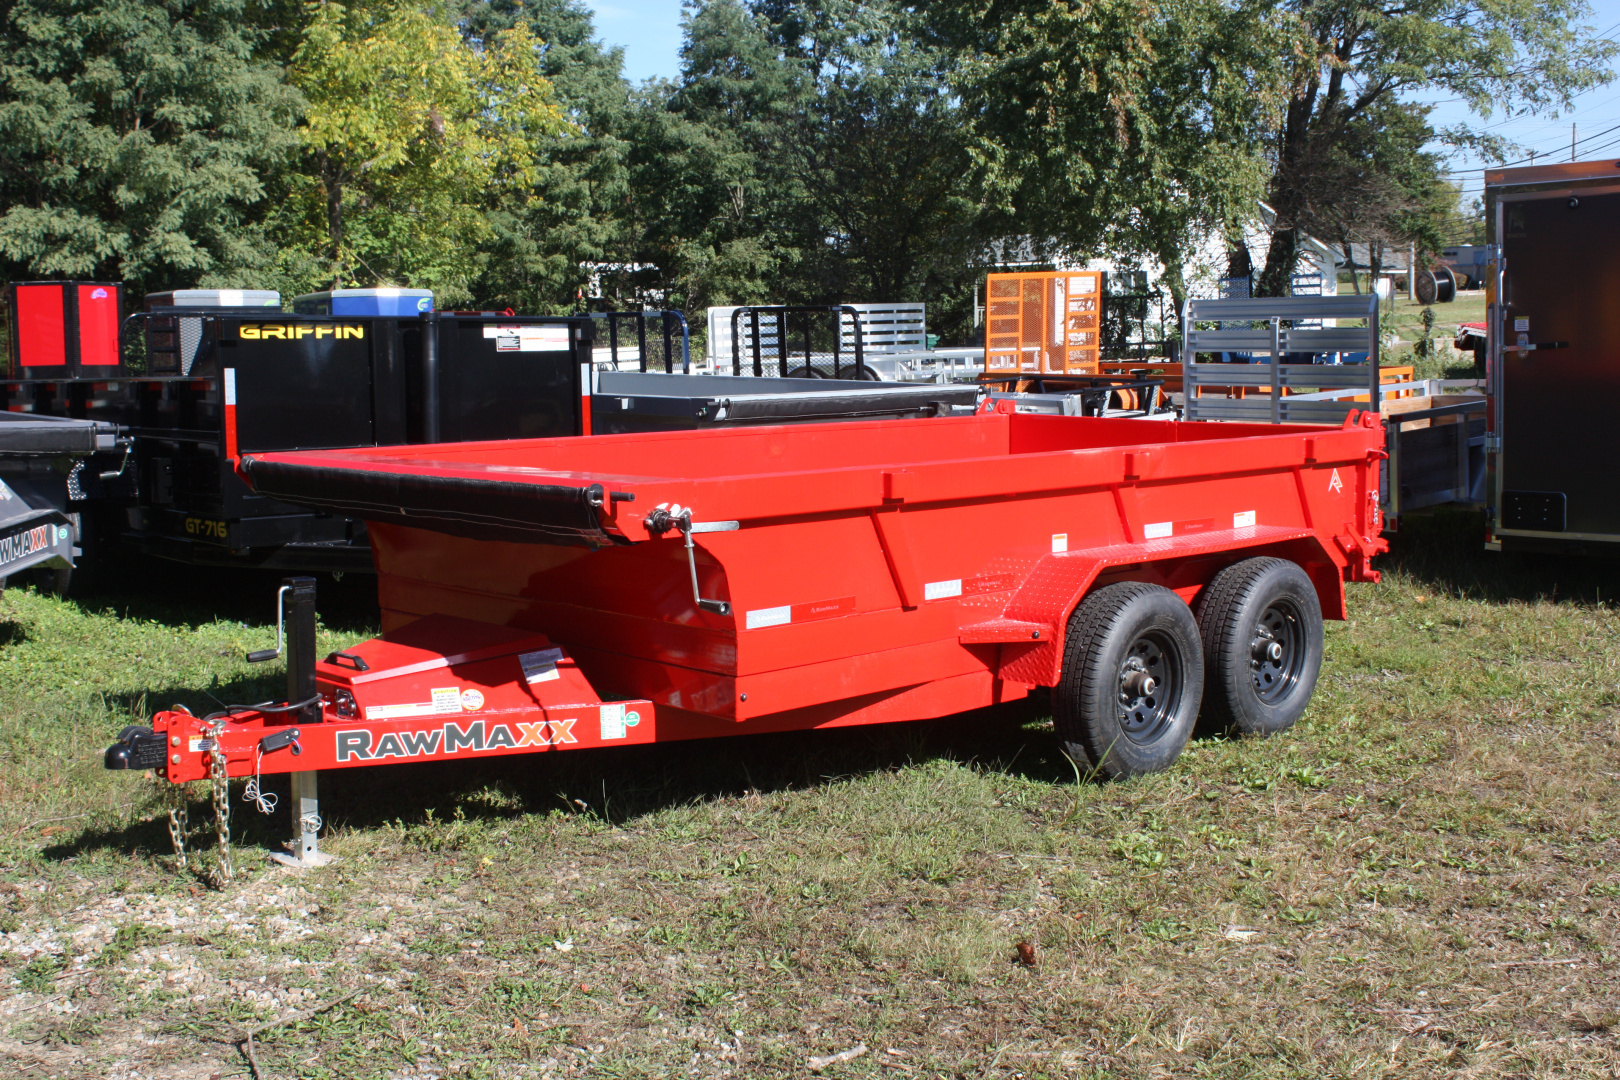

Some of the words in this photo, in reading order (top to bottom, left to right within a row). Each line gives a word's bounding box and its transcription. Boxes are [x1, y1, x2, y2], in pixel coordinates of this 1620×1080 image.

[239, 324, 364, 340] GRIFFIN
[185, 517, 227, 538] GT-716
[0, 524, 48, 566] WMAXX
[335, 718, 578, 762] RAWMAXX
